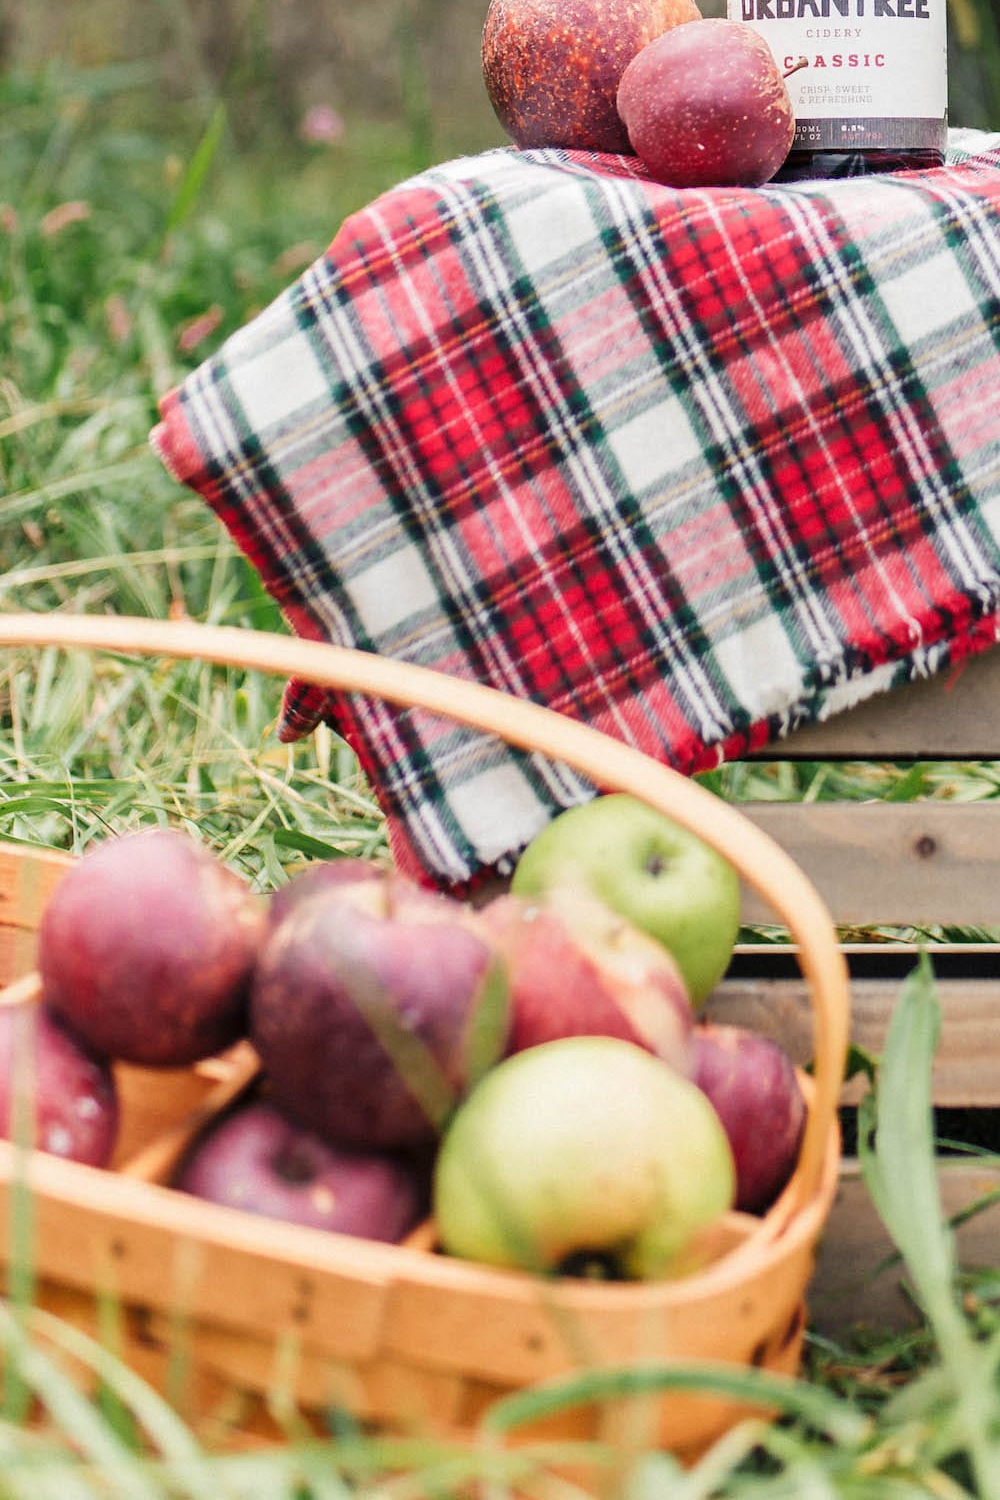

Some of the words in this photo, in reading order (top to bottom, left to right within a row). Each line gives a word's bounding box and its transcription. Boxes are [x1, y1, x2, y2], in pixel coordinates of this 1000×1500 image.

[806, 28, 862, 38] CIDERY
[783, 53, 885, 69] CASSIC
[808, 95, 873, 104] REFRESHING
[796, 125, 821, 133] 50ML
